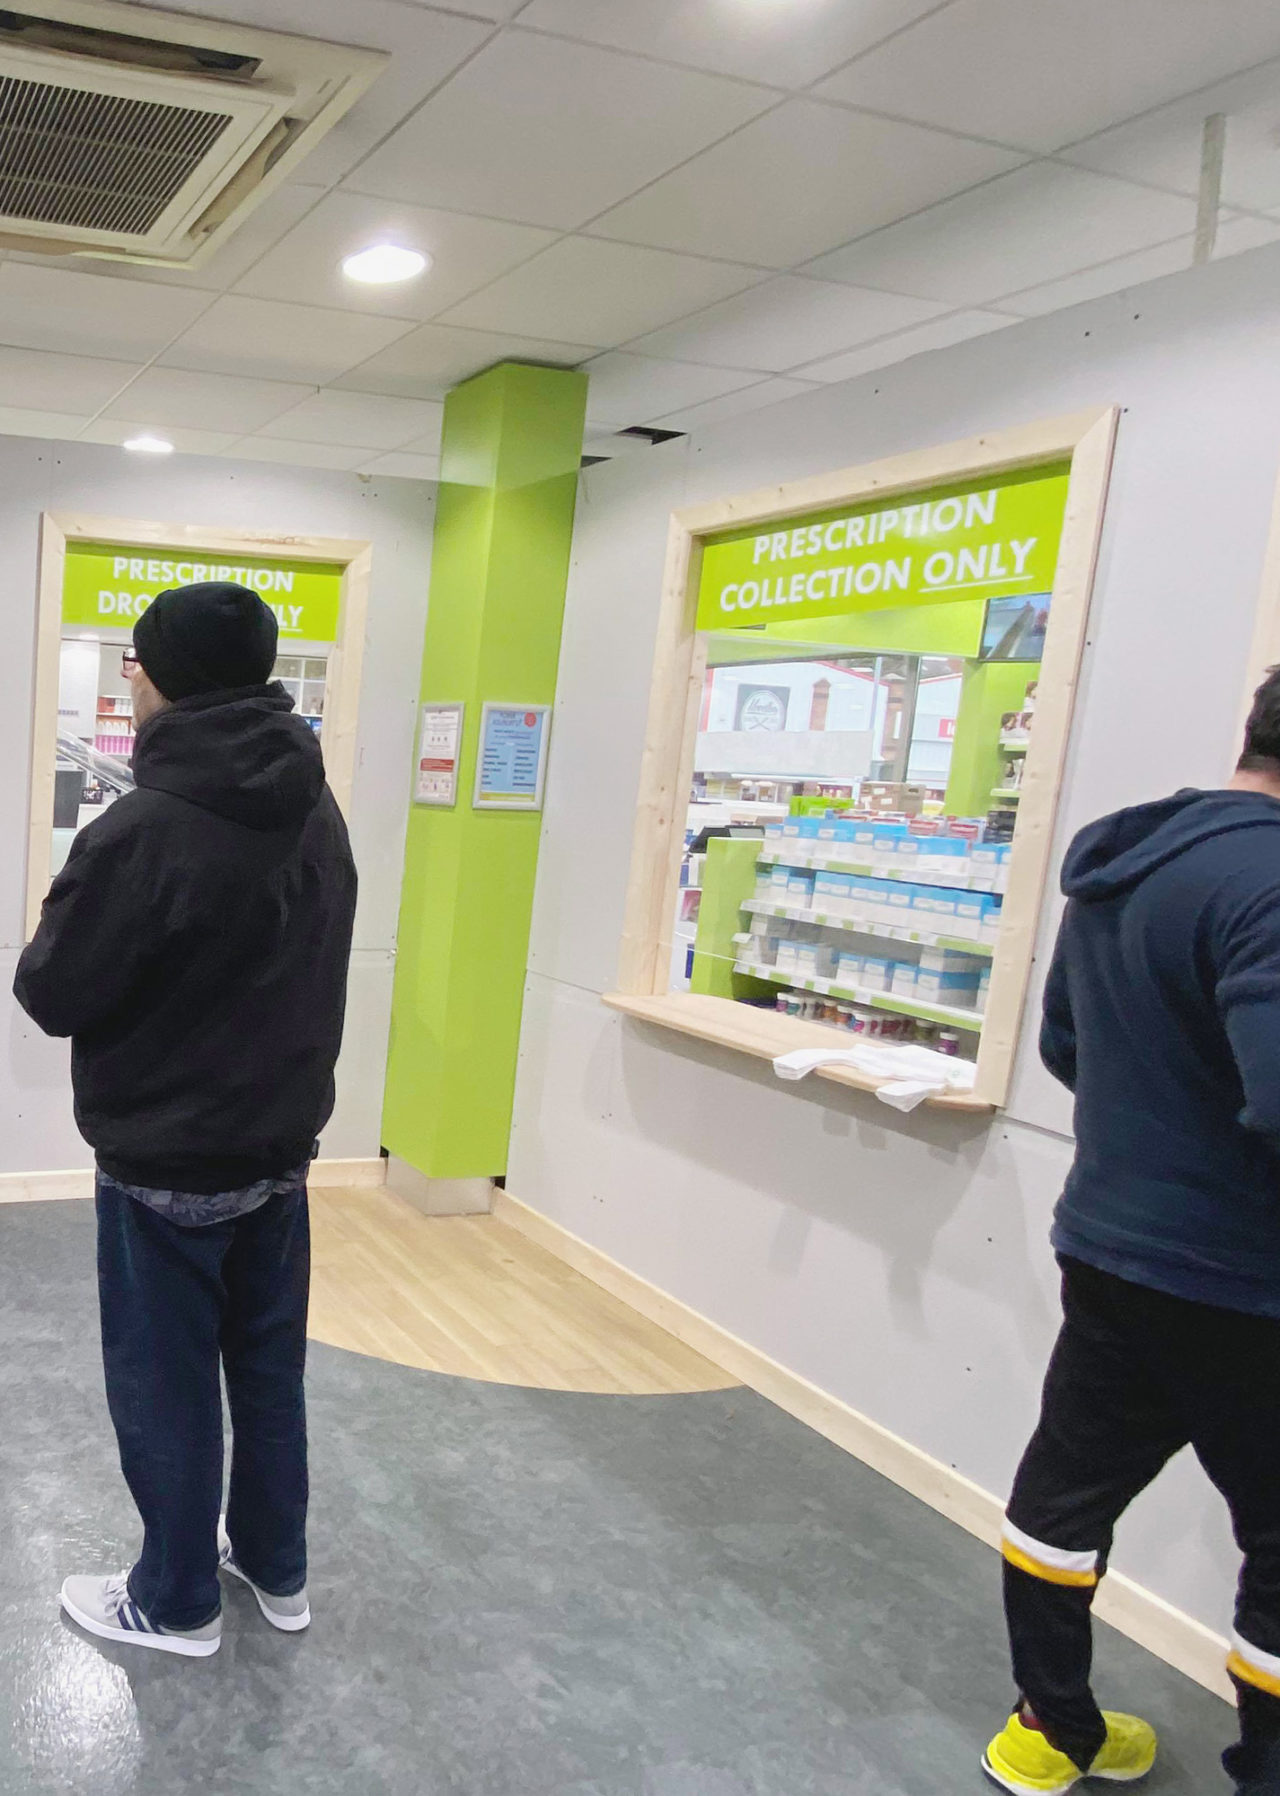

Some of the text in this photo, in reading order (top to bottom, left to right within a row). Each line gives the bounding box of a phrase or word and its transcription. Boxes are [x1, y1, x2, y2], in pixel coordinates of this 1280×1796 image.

[753, 489, 998, 564] PRESCRIPTION
[113, 556, 294, 592] PRESCRIPTION
[720, 537, 1037, 612] COLLECTION ONLY
[98, 590, 156, 616] DRO
